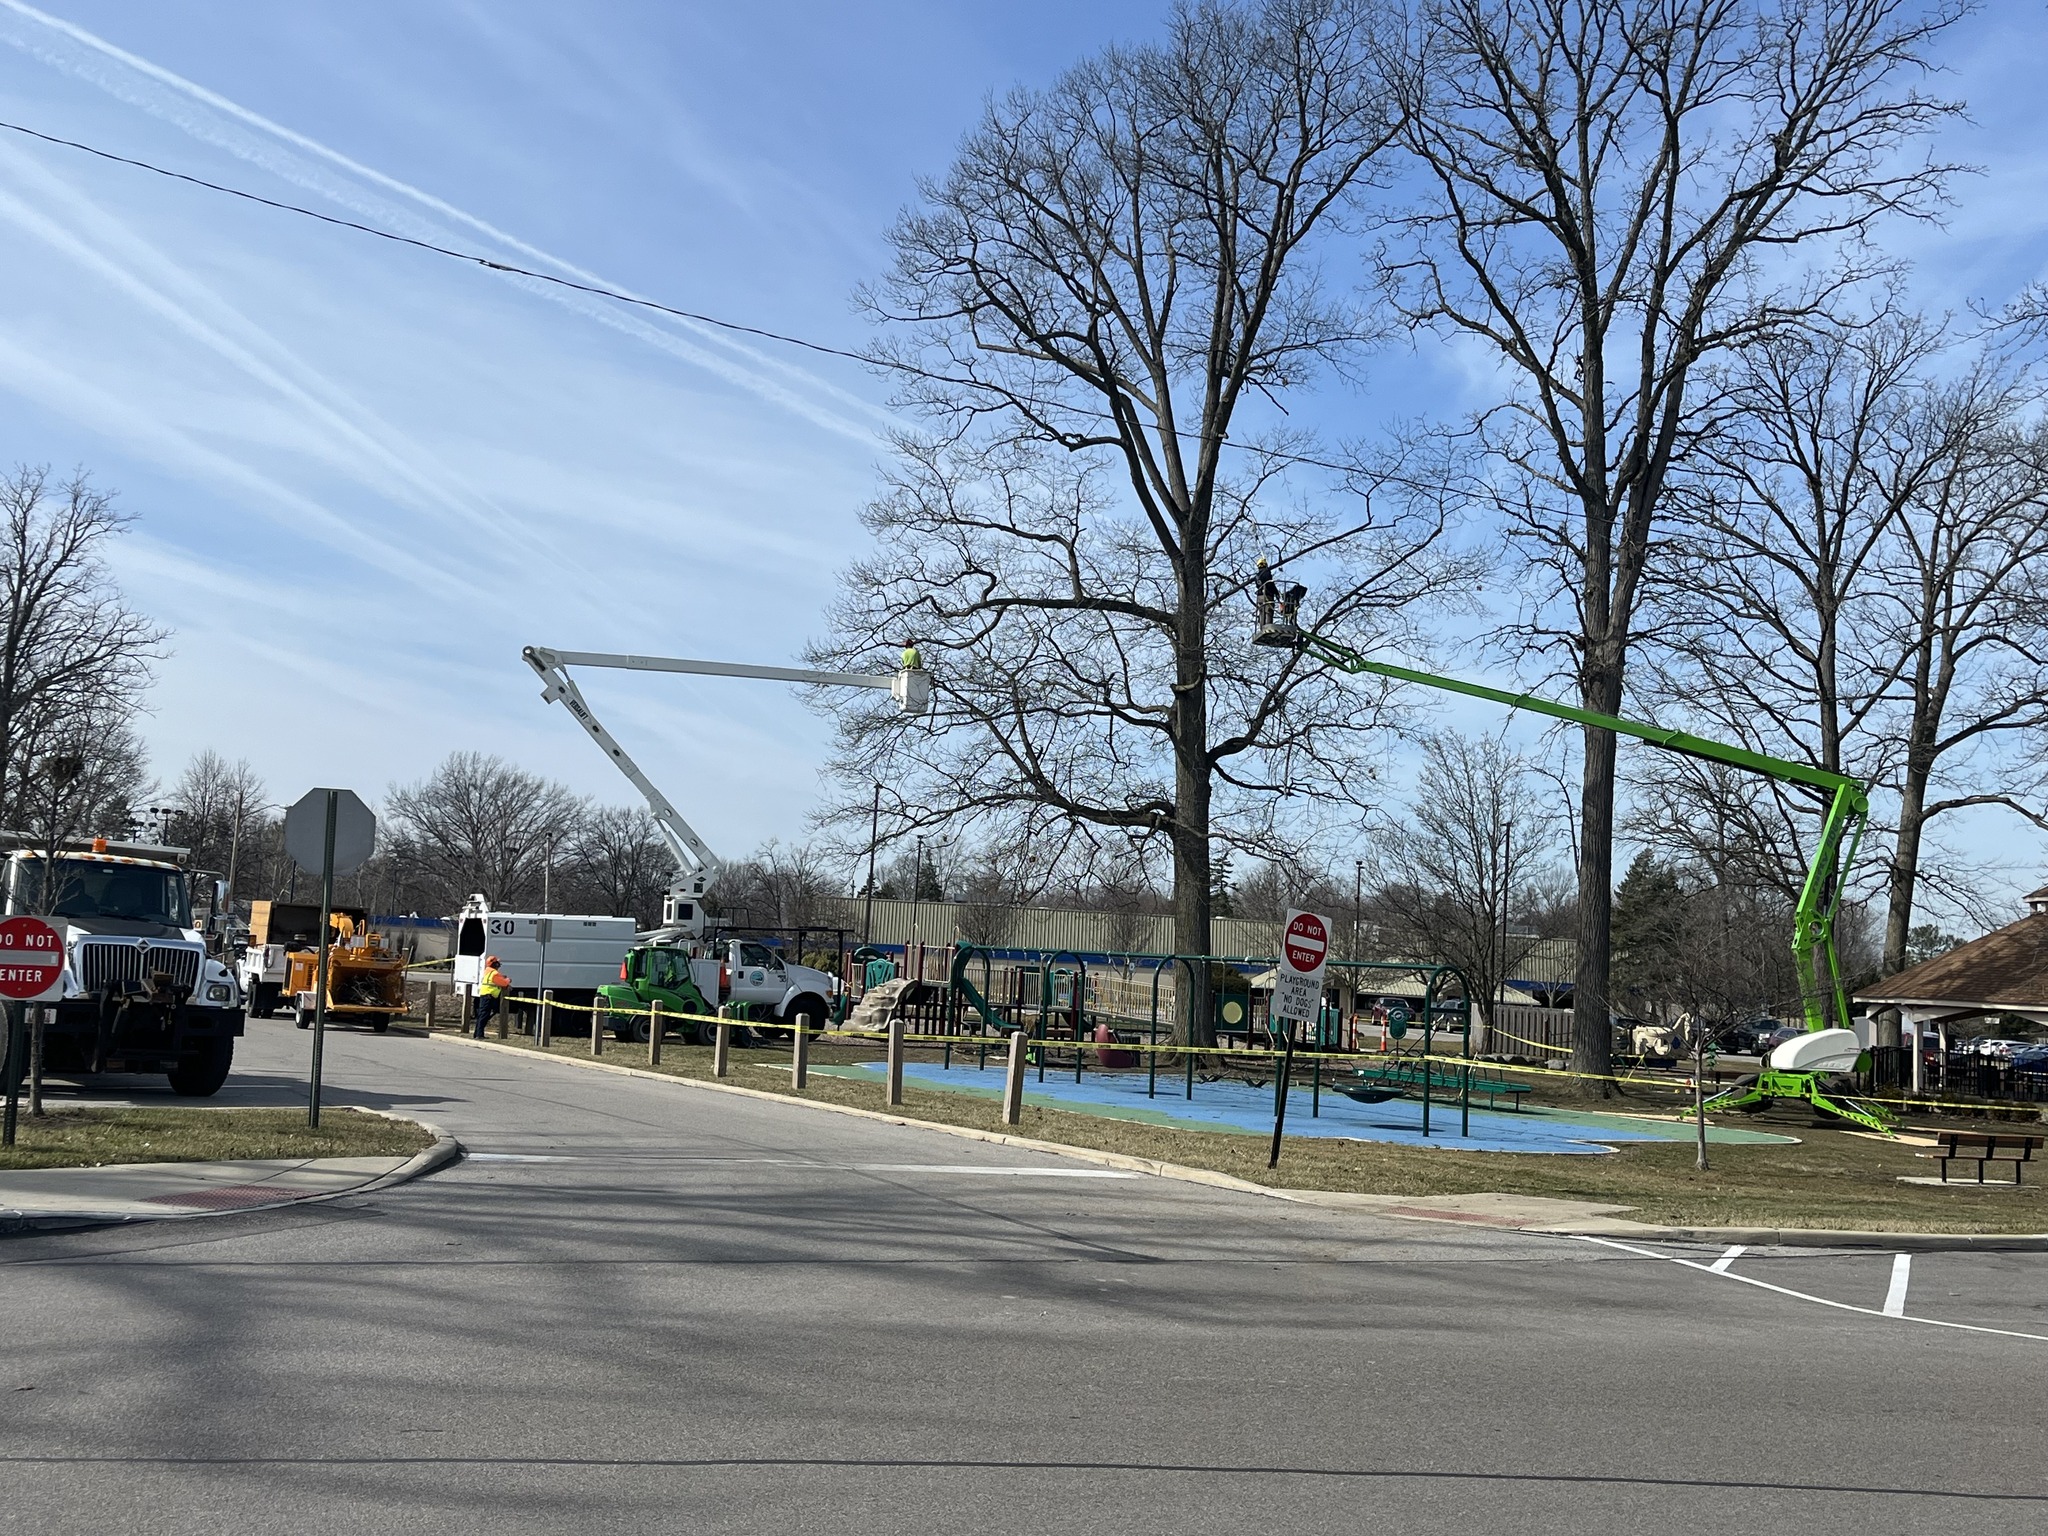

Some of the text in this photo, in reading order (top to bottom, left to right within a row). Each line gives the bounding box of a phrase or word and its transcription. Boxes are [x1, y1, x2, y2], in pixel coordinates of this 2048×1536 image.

[490, 919, 515, 935] 30
[1293, 921, 1322, 937] DO NOT
[0, 933, 54, 947] O NOT
[1292, 950, 1315, 964] ENTER
[0, 968, 42, 982] ENTER
[1280, 973, 1320, 990] PLAYGROUND
[1290, 986, 1307, 997] AREA
[1282, 1004, 1310, 1018] ALLOWED
